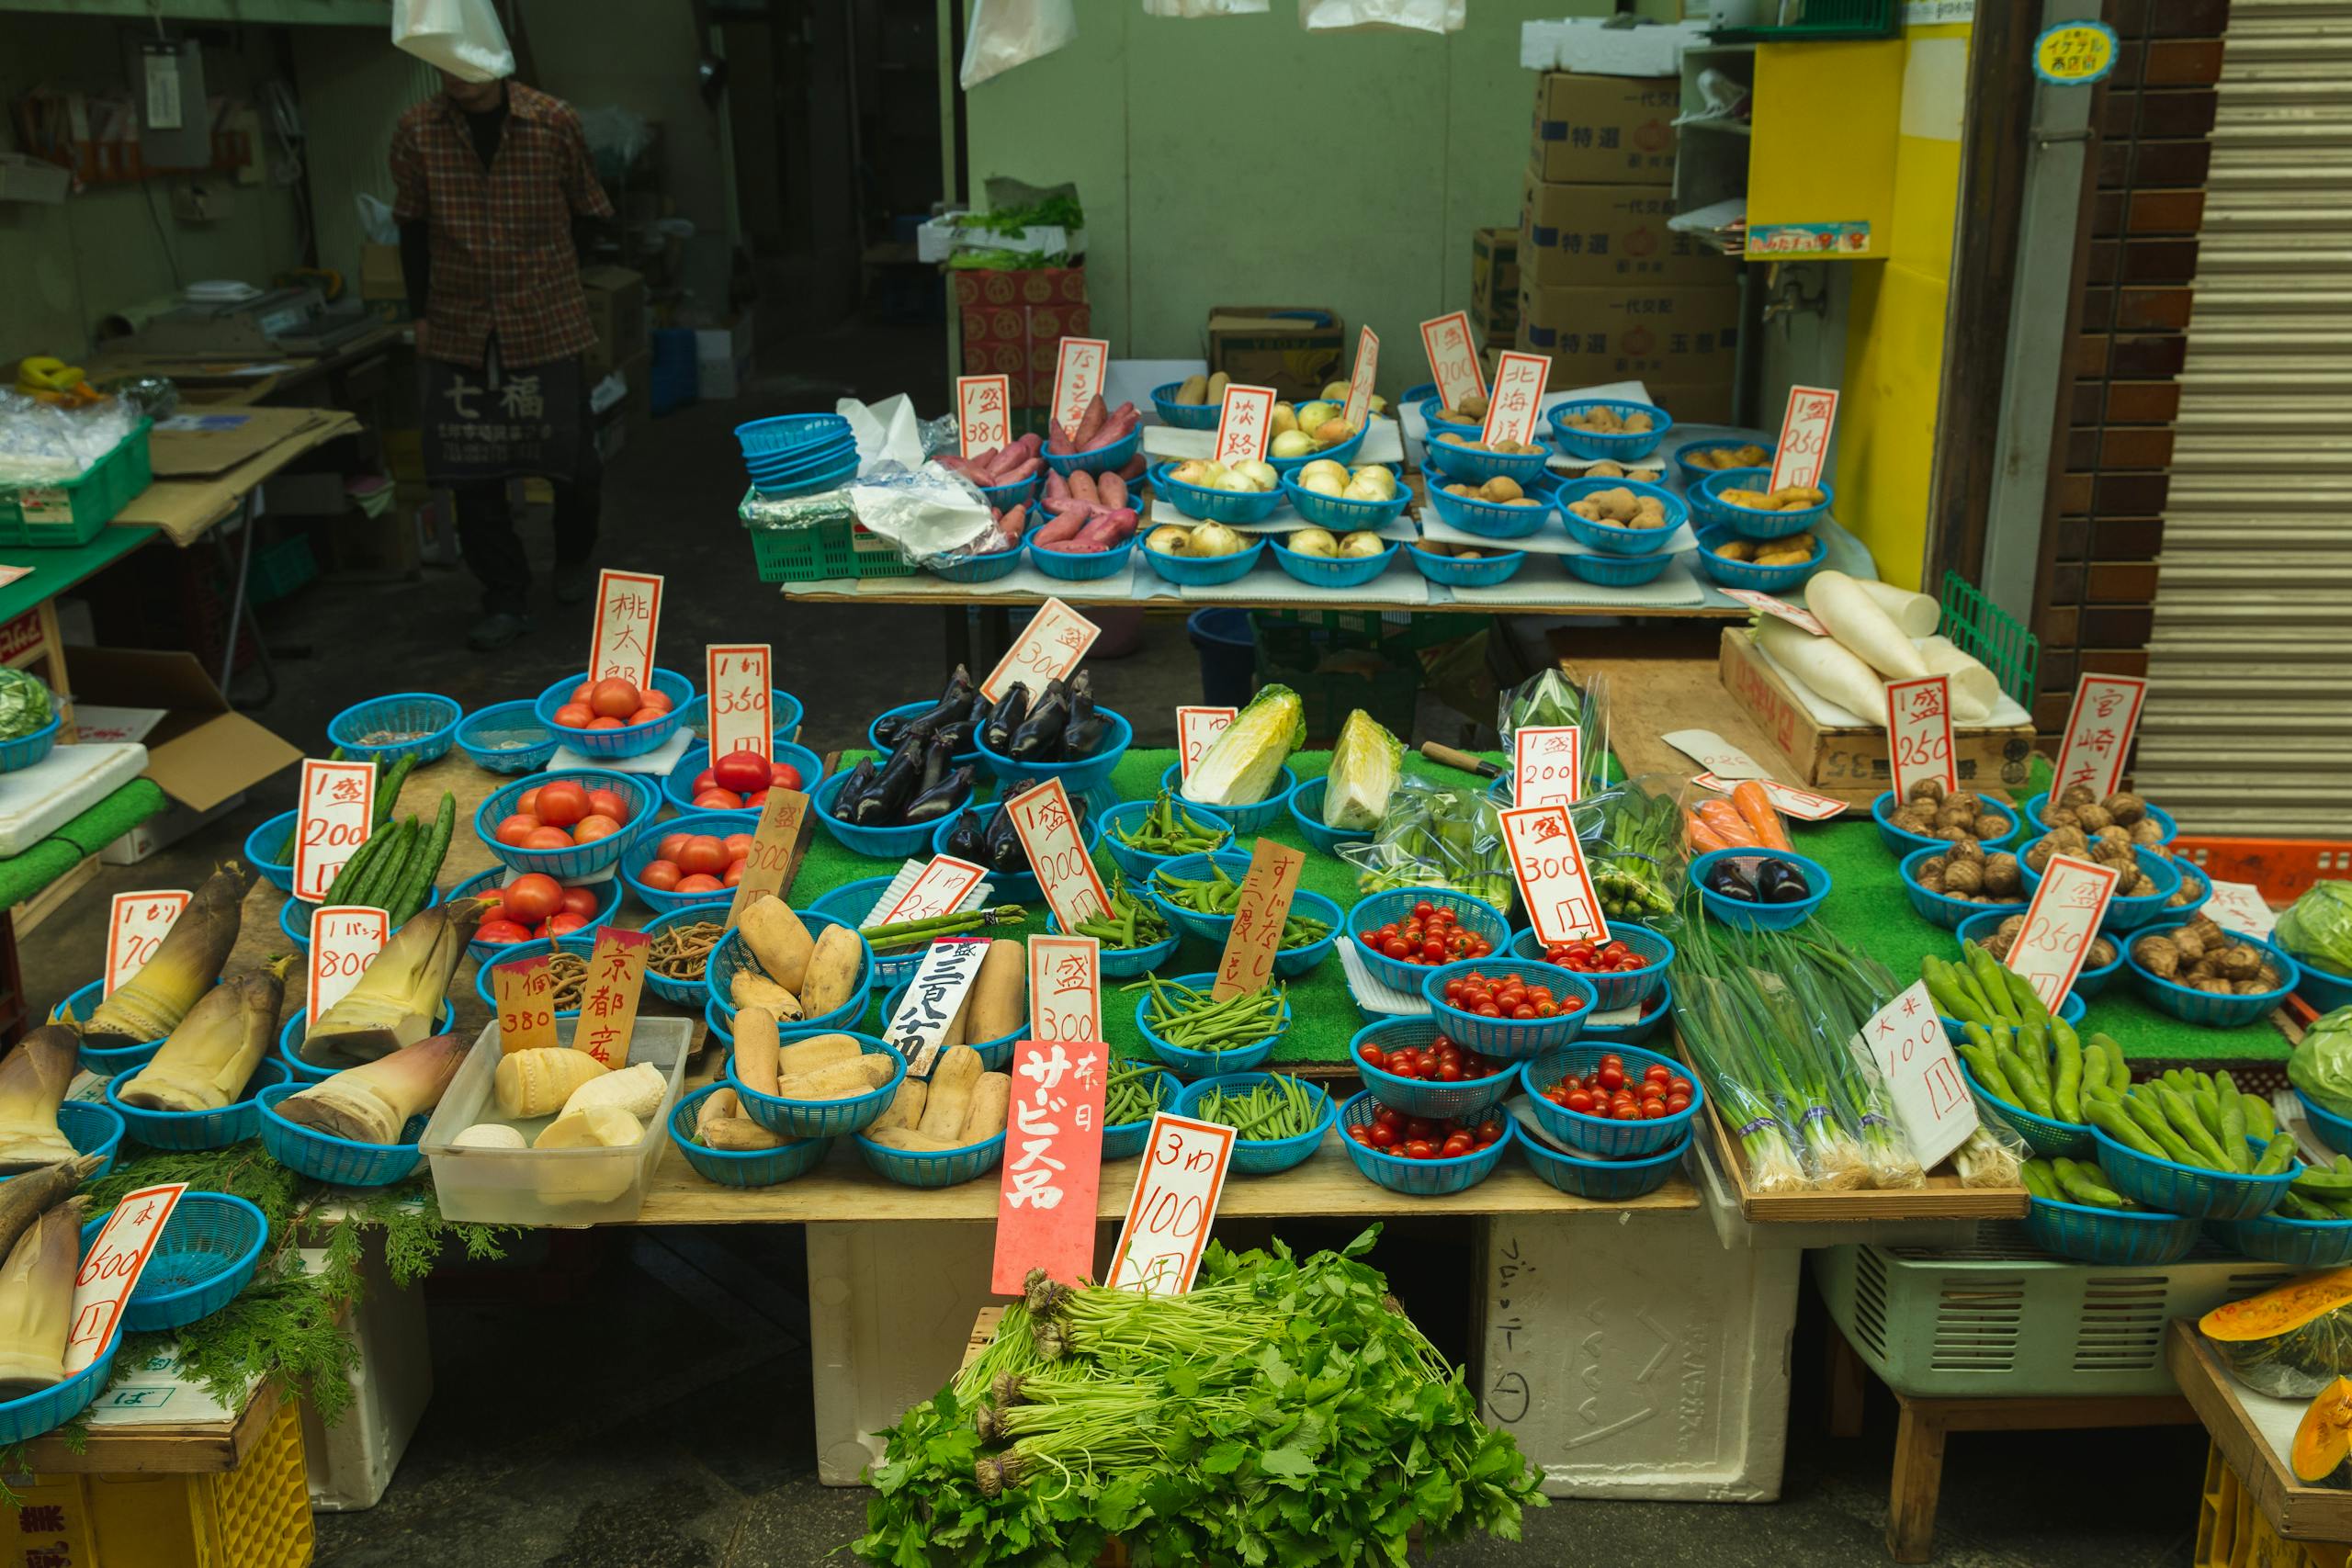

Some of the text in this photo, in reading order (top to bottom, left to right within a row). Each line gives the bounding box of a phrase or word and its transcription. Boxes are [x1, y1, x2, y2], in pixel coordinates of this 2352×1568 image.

[1572, 127, 1620, 149] 特選
[1562, 234, 1609, 255] 特選
[1609, 299, 1674, 315] 一代交配
[1559, 333, 1607, 355] 特選
[1438, 357, 1473, 387] 200
[443, 373, 545, 420] 七福
[1491, 366, 1535, 446] 北海道
[967, 422, 1004, 443] 380
[1224, 399, 1257, 469] 淡路
[1785, 429, 1824, 455] 250
[603, 592, 650, 687] 桃太郎
[1015, 640, 1065, 681] 300
[715, 685, 768, 715] 350
[1898, 728, 1952, 768] 250
[1522, 764, 1571, 784] 200
[303, 818, 367, 847] 200
[745, 840, 790, 872] 300
[1040, 846, 1087, 892] 200
[1522, 854, 1581, 884] 300
[1252, 855, 1295, 977] すじなし
[2027, 916, 2084, 953] 250
[502, 1010, 549, 1033] 380
[1038, 1006, 1093, 1043] 300
[1890, 1019, 1936, 1078] 100
[1073, 1049, 1100, 1133] 本日
[1005, 1043, 1073, 1210] サービス品
[1133, 1186, 1204, 1238] 100
